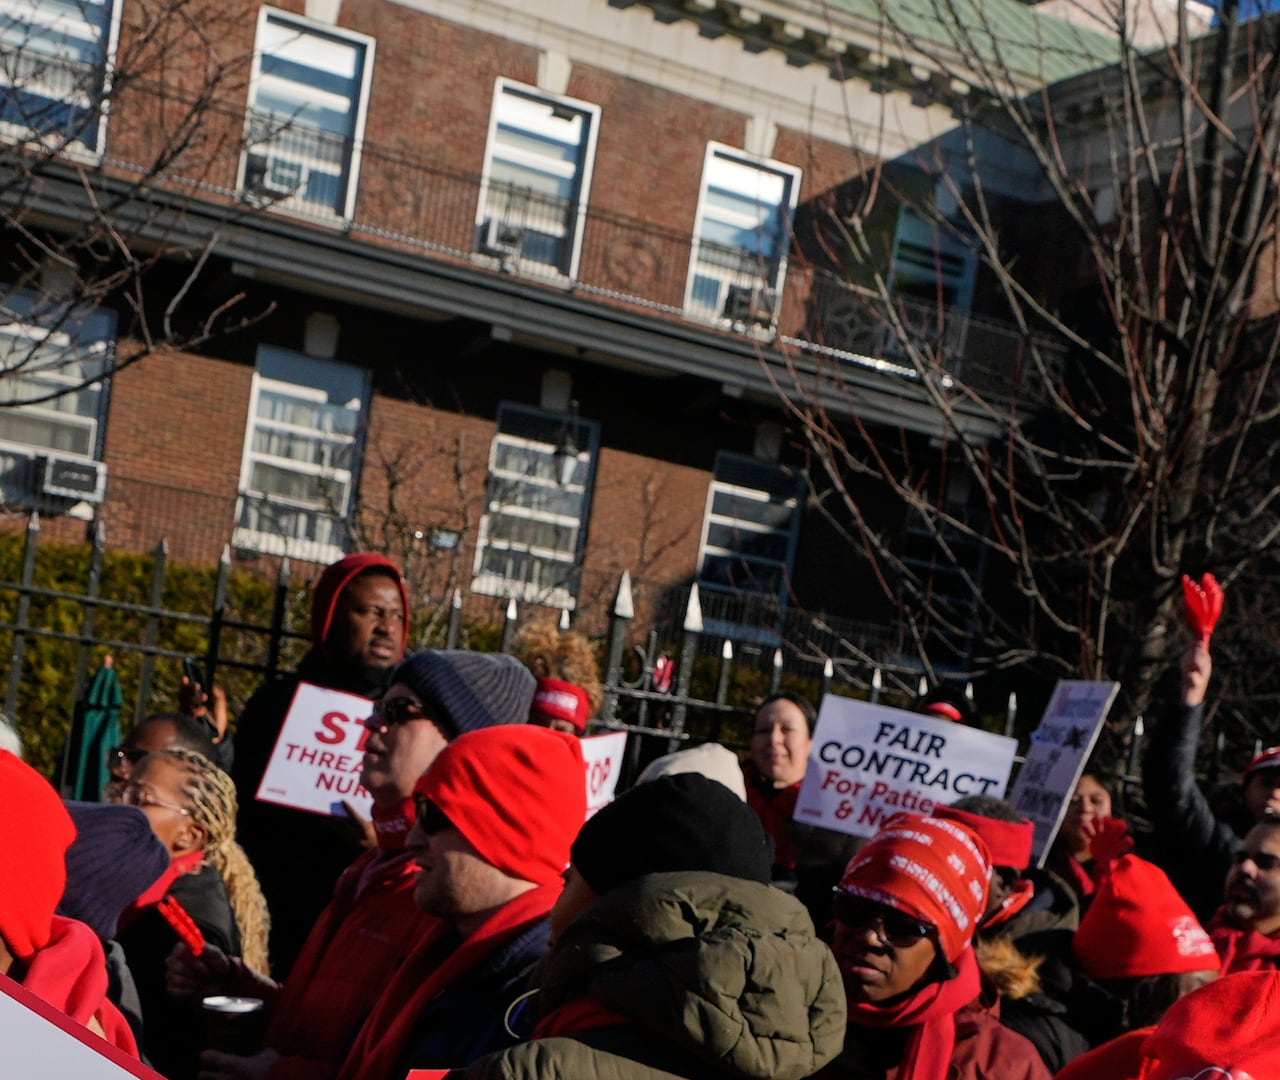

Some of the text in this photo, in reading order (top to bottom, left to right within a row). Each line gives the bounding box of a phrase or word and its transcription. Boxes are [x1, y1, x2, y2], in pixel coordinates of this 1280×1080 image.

[315, 711, 372, 752] ST
[874, 722, 946, 758] FAIR
[286, 743, 365, 774] THREA
[819, 741, 998, 796] CONTRACT
[315, 772, 368, 799] NUR
[822, 769, 935, 814] For Patie
[834, 800, 854, 820] &
